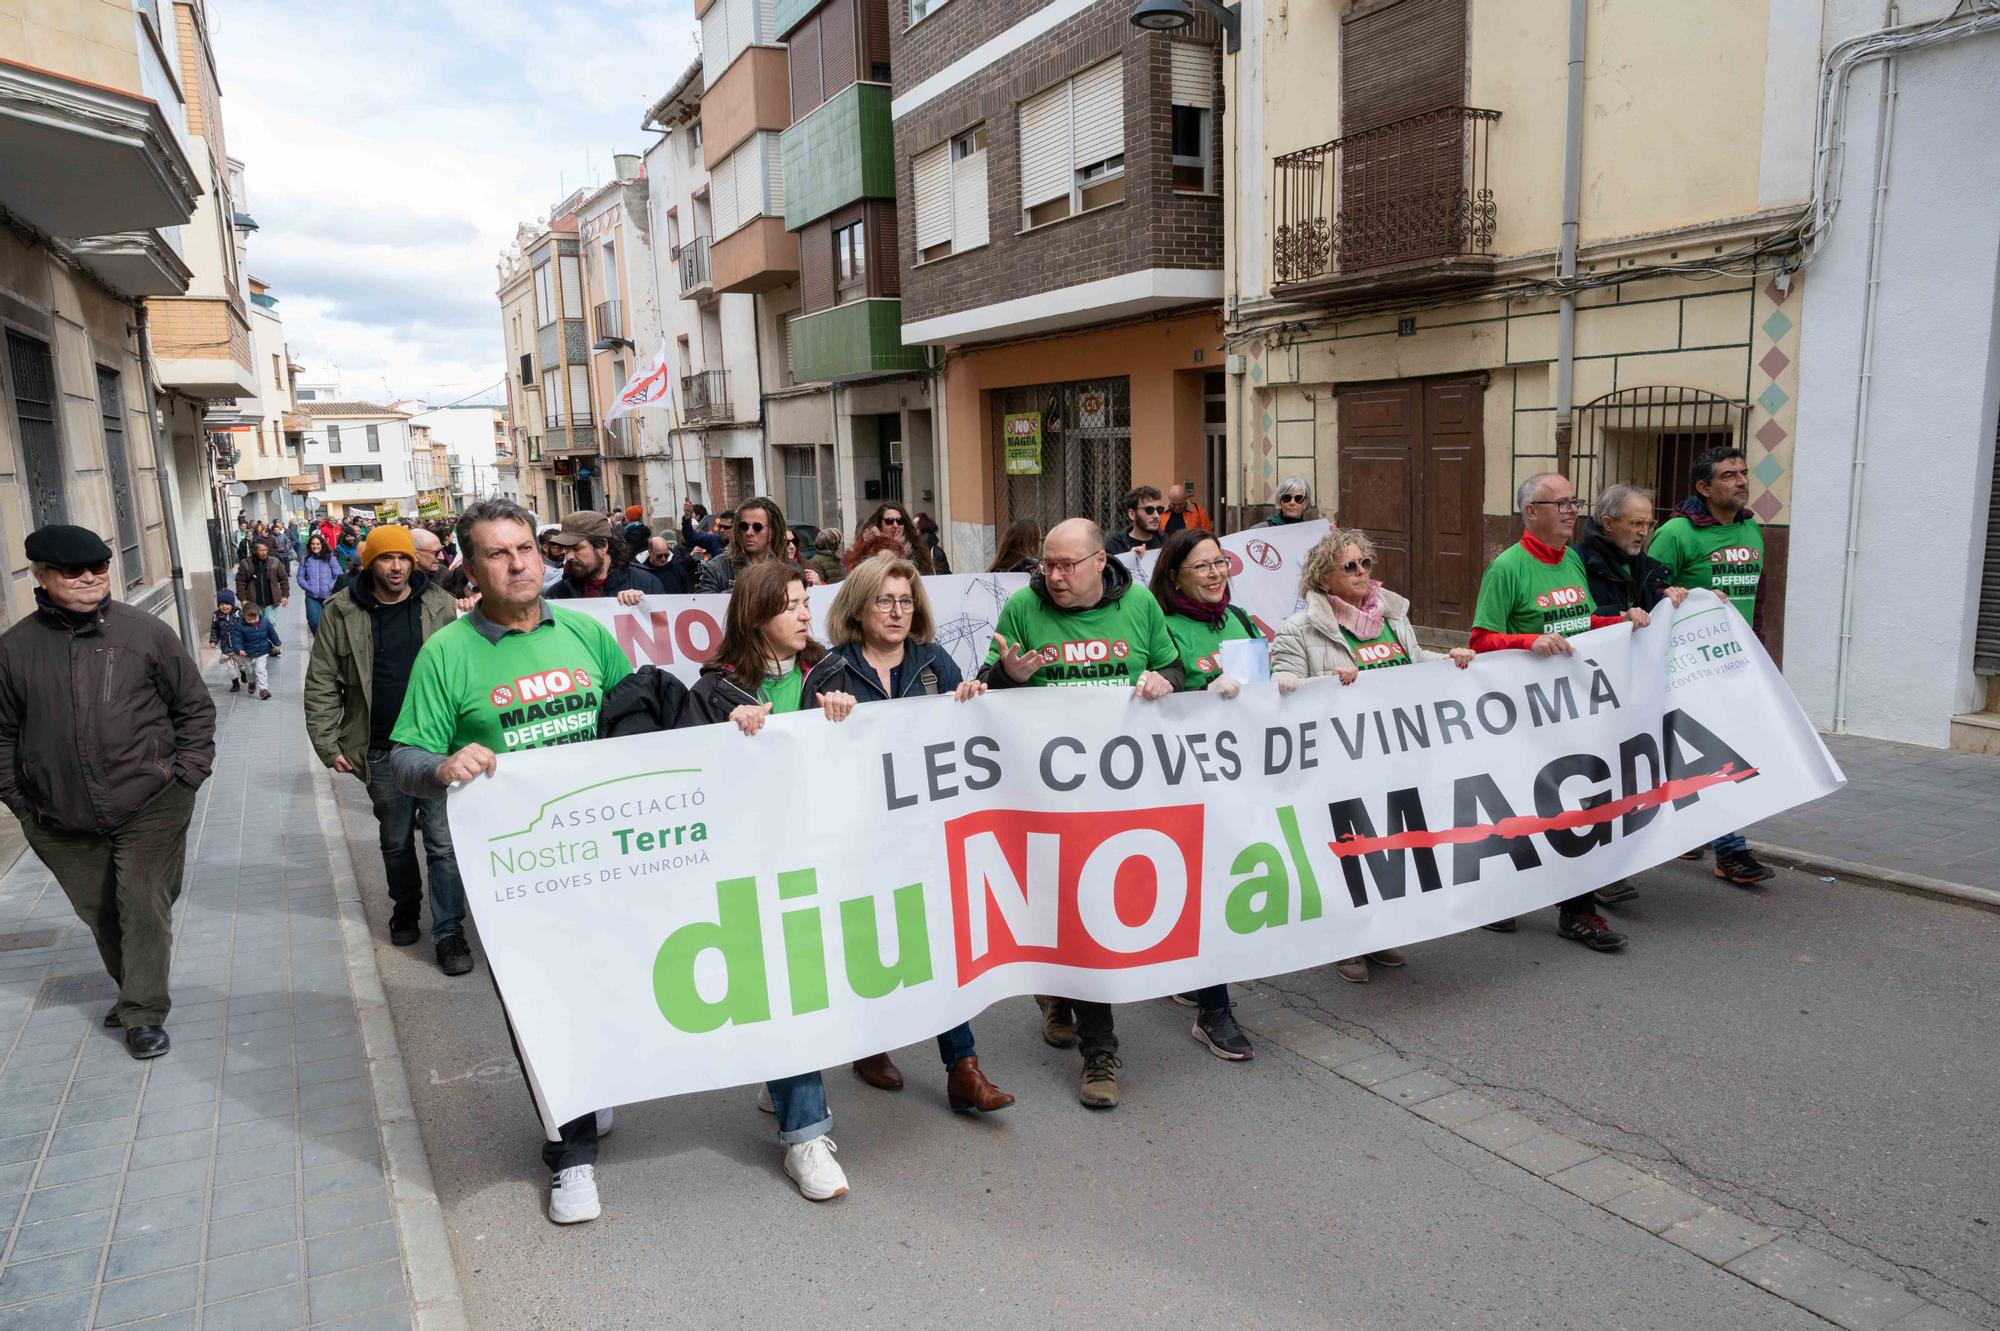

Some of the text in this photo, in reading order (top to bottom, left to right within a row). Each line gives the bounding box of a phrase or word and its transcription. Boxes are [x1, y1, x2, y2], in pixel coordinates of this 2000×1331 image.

[1015, 420, 1029, 433] NO
[1008, 436, 1036, 446] MAGDA
[419, 496, 431, 505] NO
[1725, 548, 1750, 561] NO
[1712, 564, 1760, 575] MAGDA
[1712, 575, 1760, 586] DEFENSE
[1552, 588, 1578, 605] NO
[1543, 603, 1591, 622] MAGDA
[1543, 616, 1591, 634] DEFENSE
[613, 609, 724, 669] NO
[1064, 642, 1107, 661] NO
[1358, 644, 1391, 662] NO
[1046, 662, 1130, 681] MAGDA
[518, 671, 571, 701] NO
[499, 691, 598, 730] MAGDA
[882, 659, 1621, 811] LES COVES DE VINROMÀ
[551, 787, 706, 830] ASSOCIACIÓ
[488, 821, 709, 878] Nostra Terra
[495, 849, 711, 903] LES COVES DE VINROMÀ
[652, 708, 1760, 1035] diu NO al MAGDA
